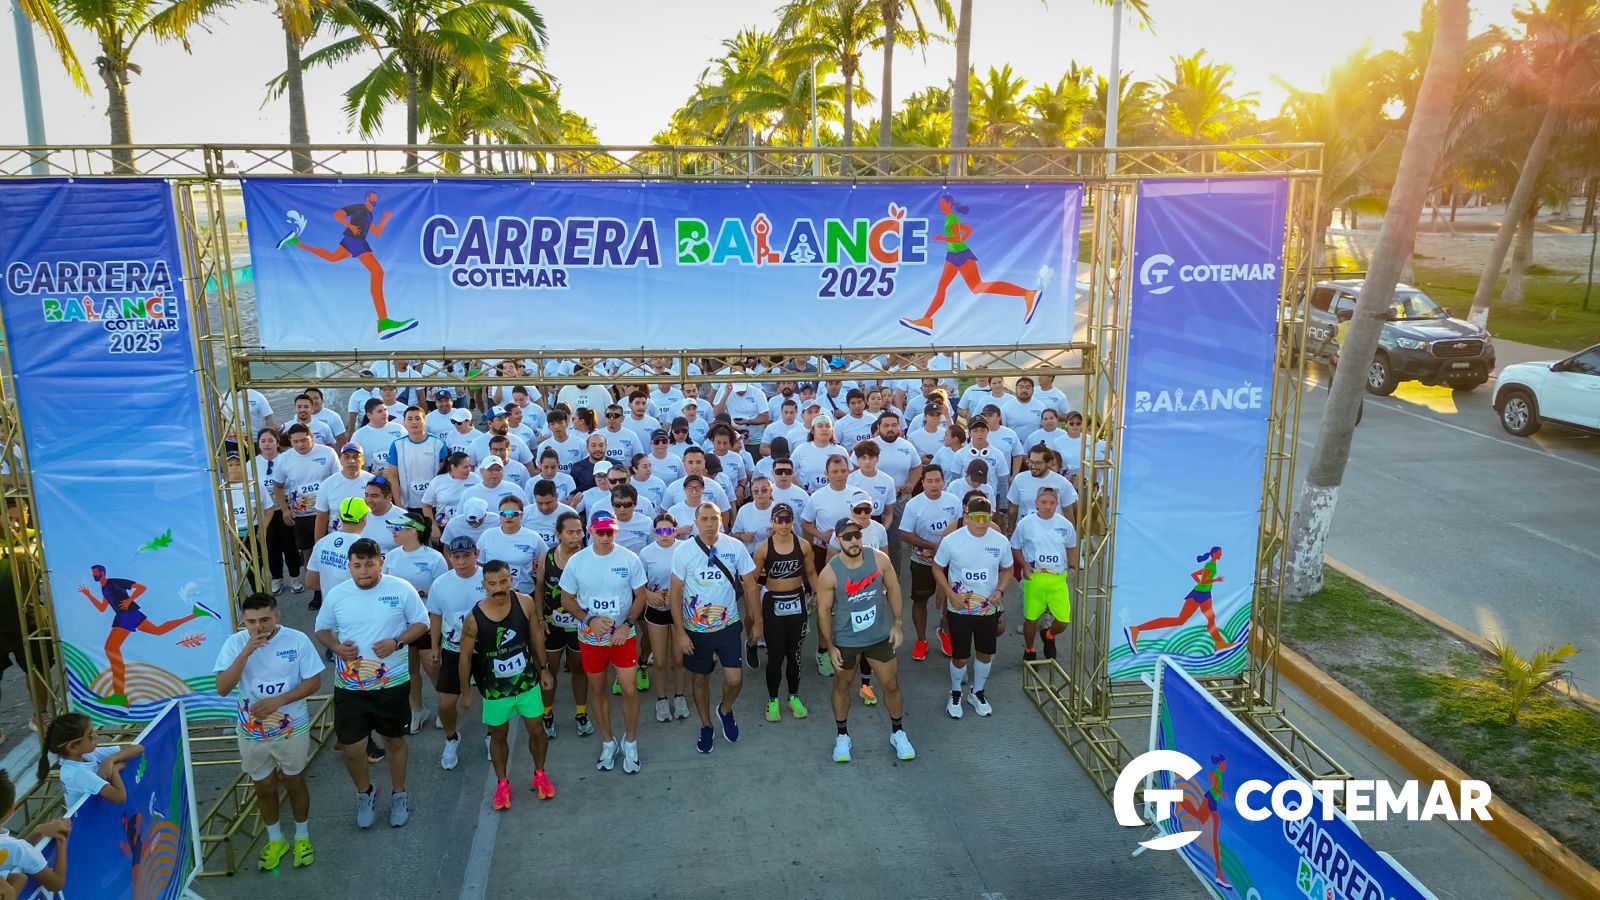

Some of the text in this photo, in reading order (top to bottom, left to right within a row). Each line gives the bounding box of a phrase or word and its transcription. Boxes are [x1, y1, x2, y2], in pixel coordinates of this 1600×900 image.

[421, 207, 927, 267] CARRERA BALANCE
[7, 261, 173, 294] CARRERA
[452, 267, 567, 288] COTEMAR
[1180, 264, 1276, 282] COTEMAR
[818, 266, 896, 299] 2025
[43, 296, 178, 321] BALANCE
[105, 319, 178, 331] COTEMAR
[110, 333, 161, 352] 2025
[1135, 382, 1262, 413] BALANCE
[606, 449, 623, 457] 090
[301, 483, 320, 494] 262
[929, 520, 948, 531] 101
[1037, 554, 1059, 563] 050
[771, 559, 799, 574] NIKE
[699, 570, 722, 580] 126
[965, 571, 987, 581] 056
[593, 599, 615, 610] 091
[854, 610, 875, 624] 043
[497, 658, 522, 672] 011
[257, 682, 286, 695] 107
